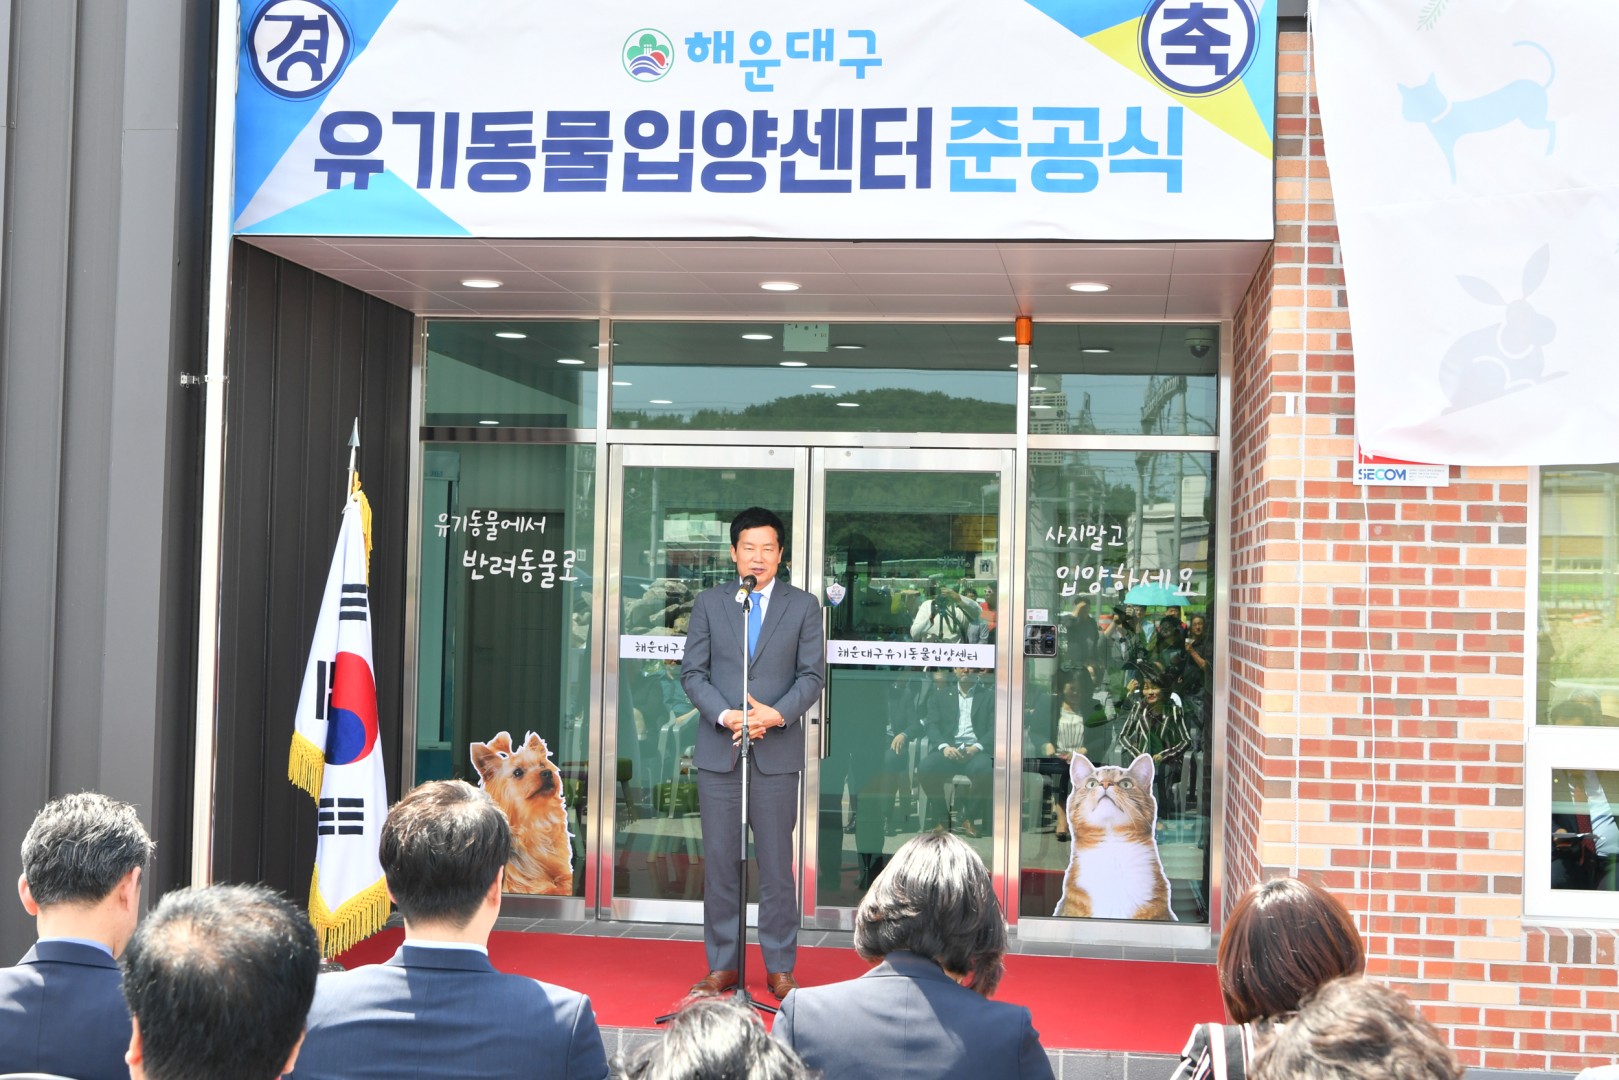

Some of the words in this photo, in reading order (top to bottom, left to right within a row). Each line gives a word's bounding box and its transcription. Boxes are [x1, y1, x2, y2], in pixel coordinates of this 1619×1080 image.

[263, 14, 328, 82] 경
[1161, 2, 1231, 76] 축
[685, 29, 882, 92] 해운대구
[1358, 468, 1407, 481] SECOM
[434, 510, 546, 541] 유기동물에서
[1045, 525, 1125, 551] 사지말고
[462, 549, 578, 589] 반려동물로
[1056, 563, 1199, 597] 입양하세요
[635, 640, 686, 655] 해운대구
[837, 645, 979, 663] 해운대구유기동물입양센터
